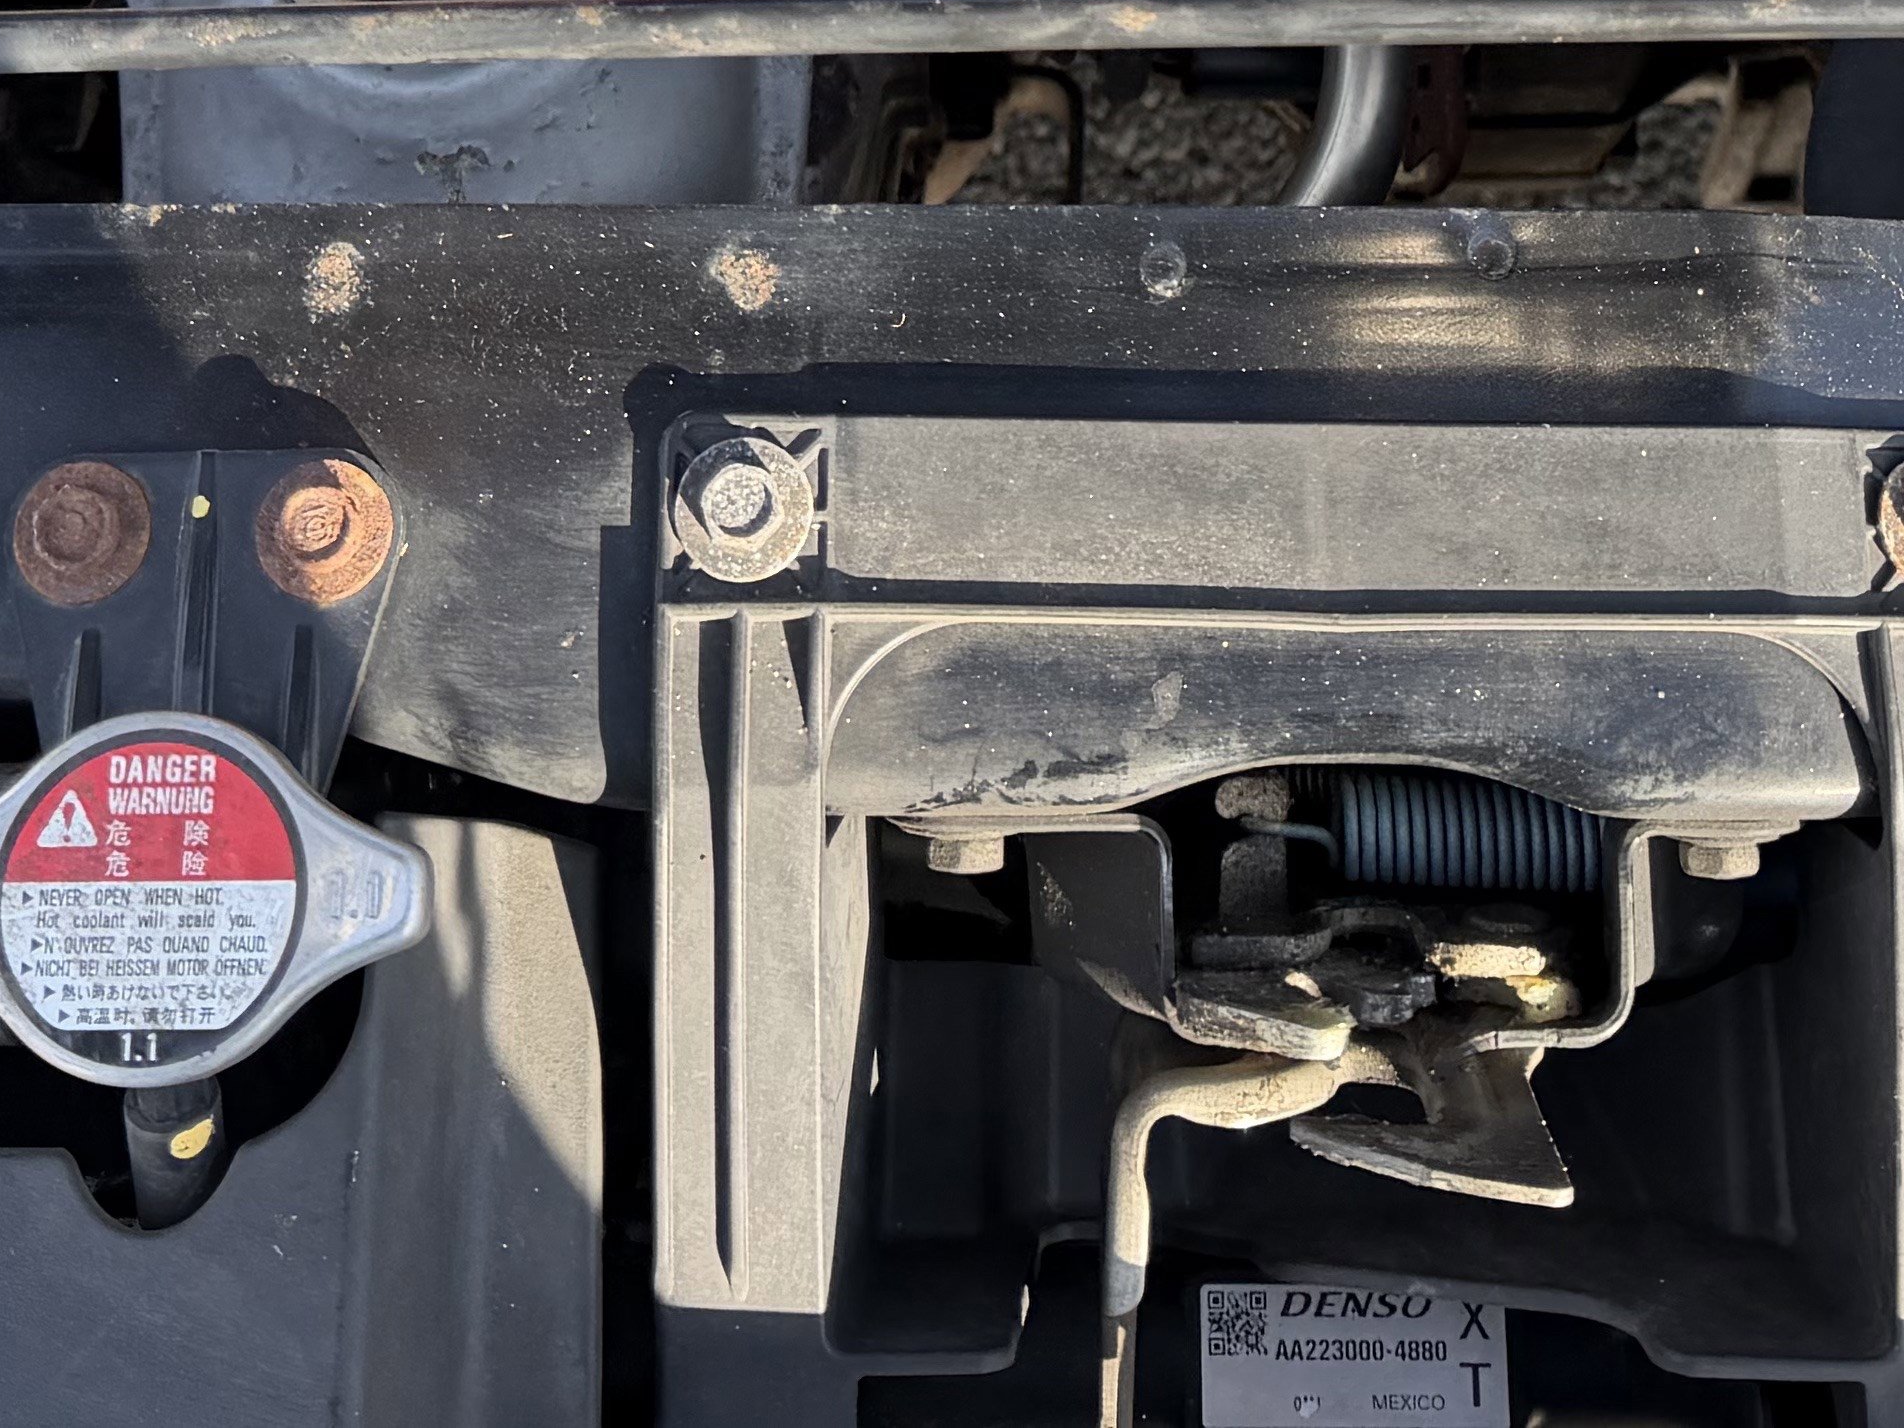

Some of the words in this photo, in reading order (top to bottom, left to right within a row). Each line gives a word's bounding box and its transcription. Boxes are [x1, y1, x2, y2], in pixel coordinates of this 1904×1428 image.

[108, 754, 217, 785] DANGER
[107, 786, 214, 816] WARNUNG
[38, 888, 83, 907] NEVER
[94, 887, 131, 907] OPEN
[144, 887, 184, 906] WHEN
[36, 910, 61, 929] Hot
[72, 910, 126, 929] coolant
[138, 909, 164, 929] will
[177, 909, 216, 929] scald
[229, 913, 256, 932] you.
[126, 935, 154, 955] PAS
[219, 935, 268, 954] CHAUD.
[34, 958, 72, 977] NICHT
[79, 958, 99, 977] BEI
[105, 958, 161, 977] HEISSEM
[166, 957, 210, 977] MOTOR
[121, 1031, 158, 1062] 1.1
[1279, 1291, 1434, 1320] DENSO
[1458, 1301, 1491, 1341] X
[1274, 1338, 1448, 1362] AA223000-4880
[1459, 1362, 1492, 1408] T
[1372, 1393, 1446, 1412] MEXICO
